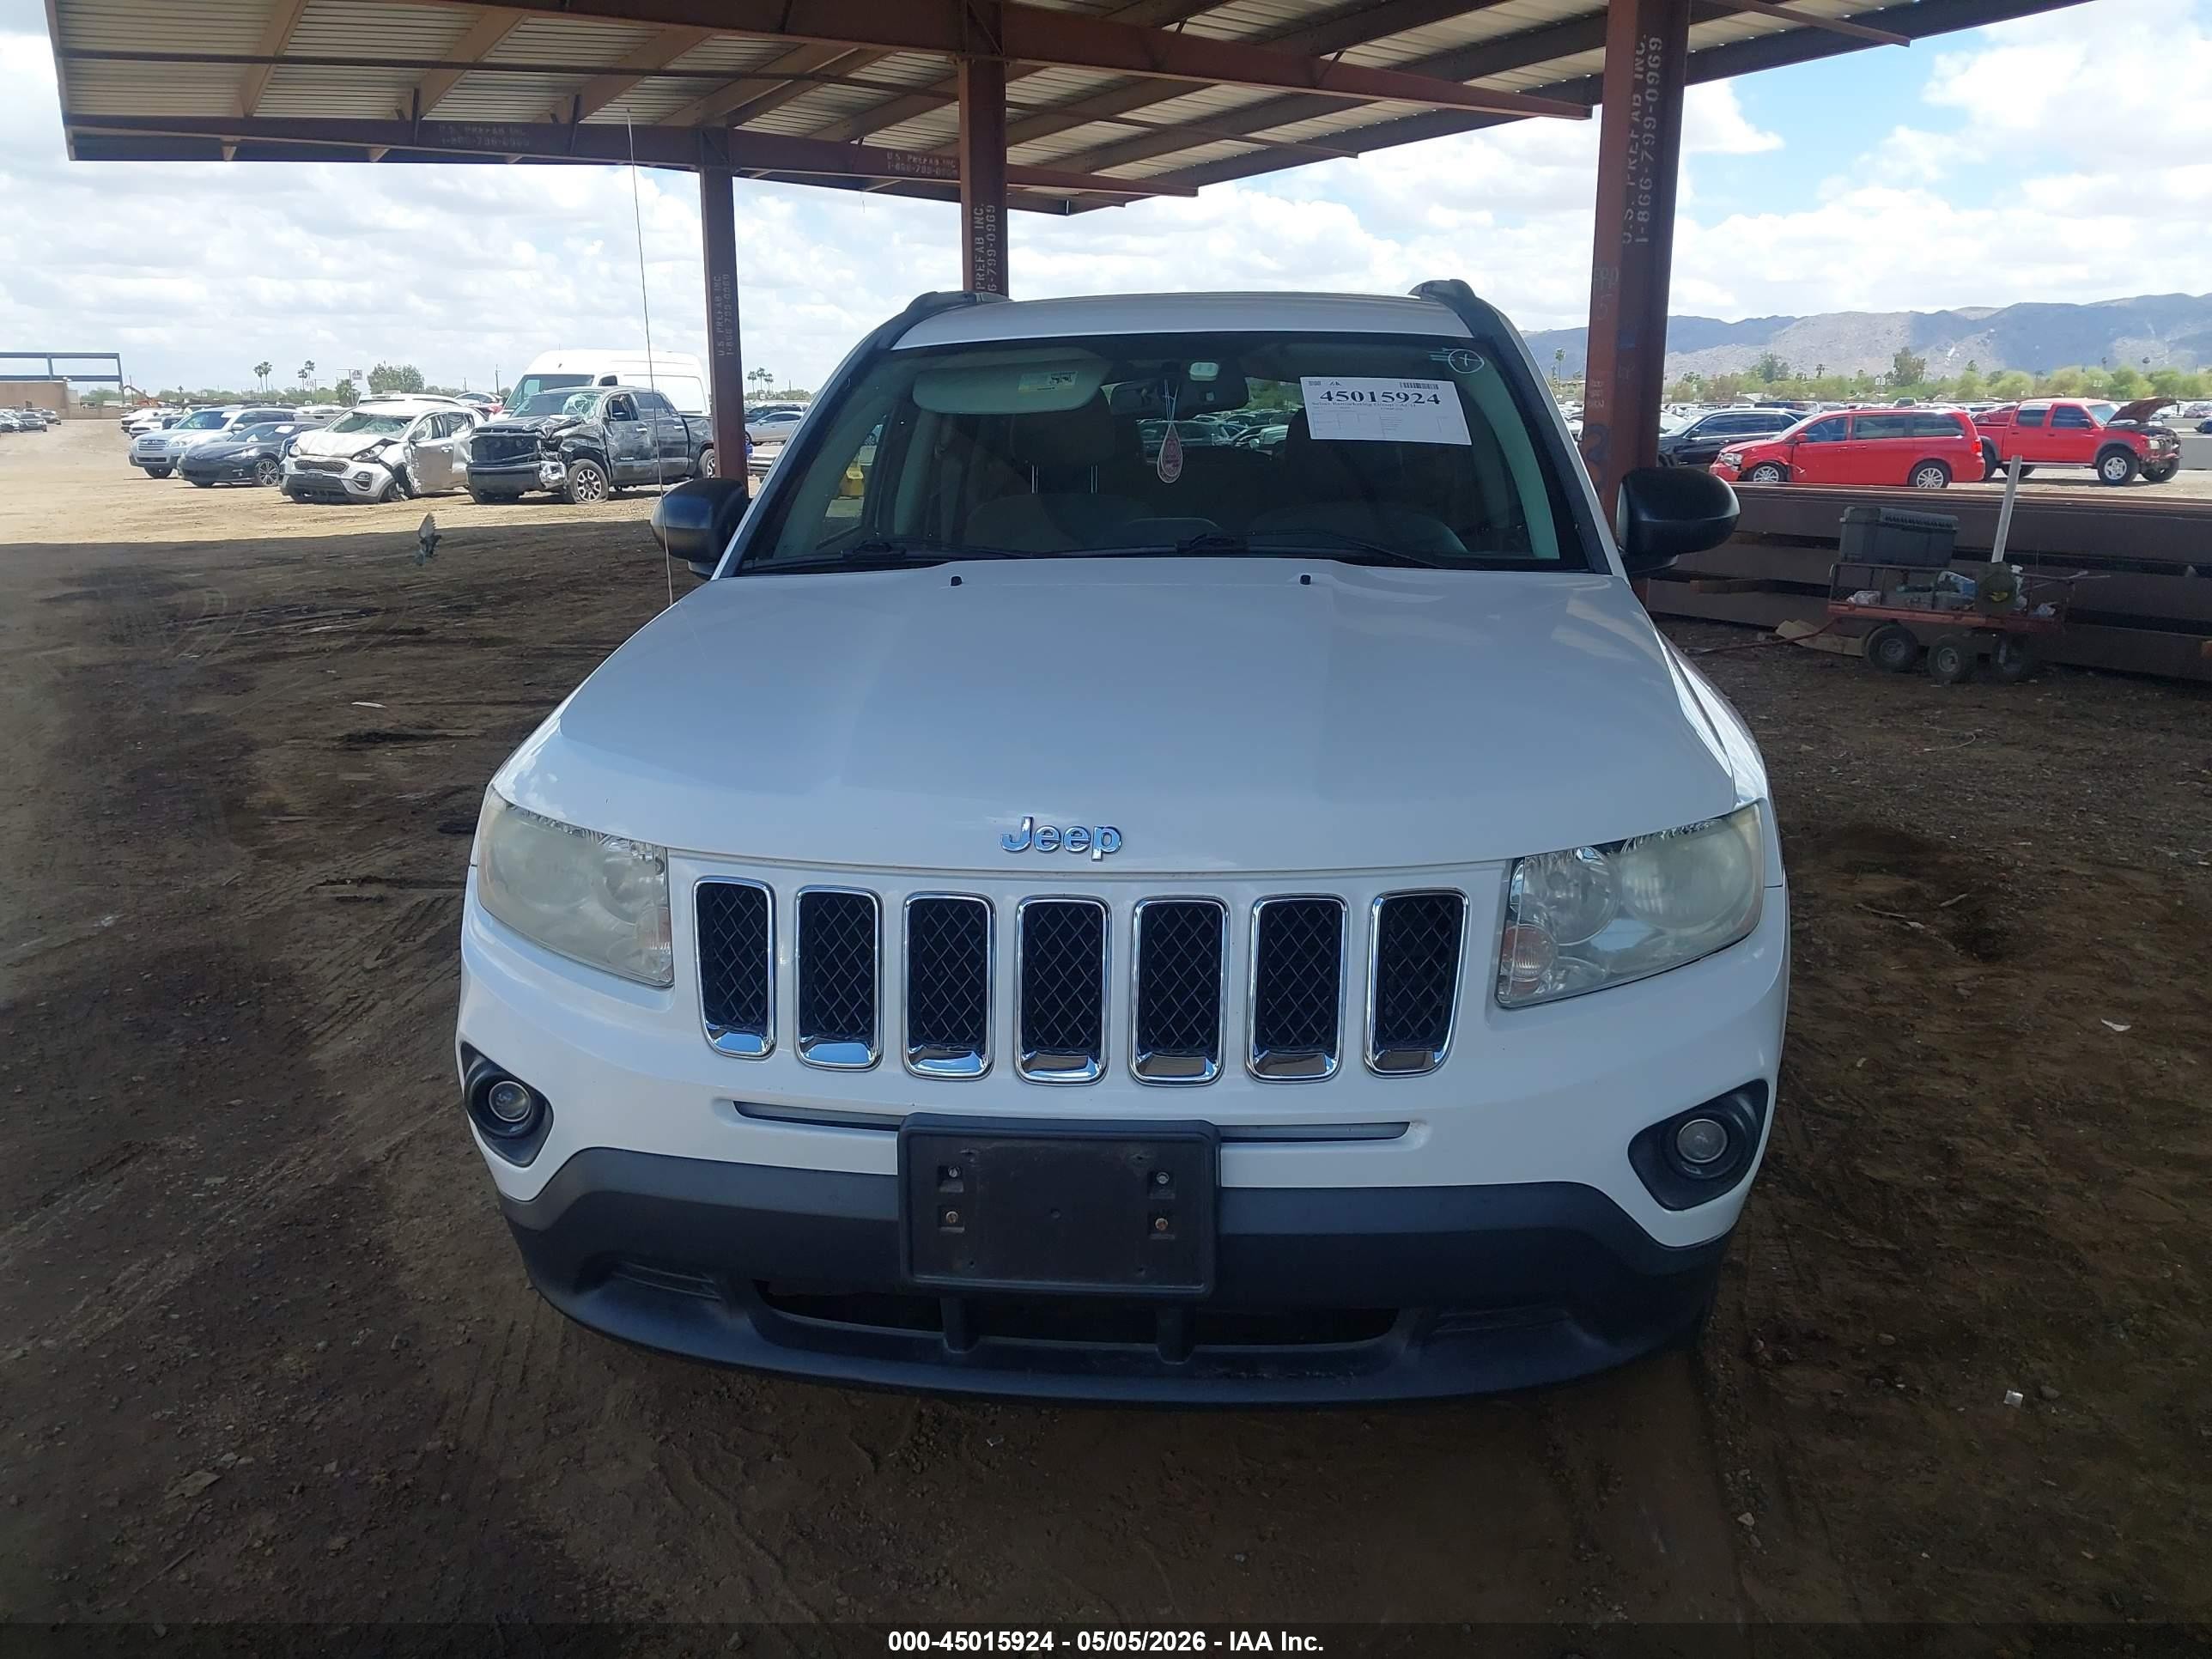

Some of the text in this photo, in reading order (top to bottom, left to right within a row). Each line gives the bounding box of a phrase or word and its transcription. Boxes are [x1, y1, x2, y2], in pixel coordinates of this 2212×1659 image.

[1634, 37, 1663, 244] 1-866-799-0969
[974, 204, 985, 289] PREFAB INC.
[986, 205, 997, 291] 6-799-0969
[1320, 390, 1442, 405] 45015924
[1001, 816, 1122, 861] Jeep
